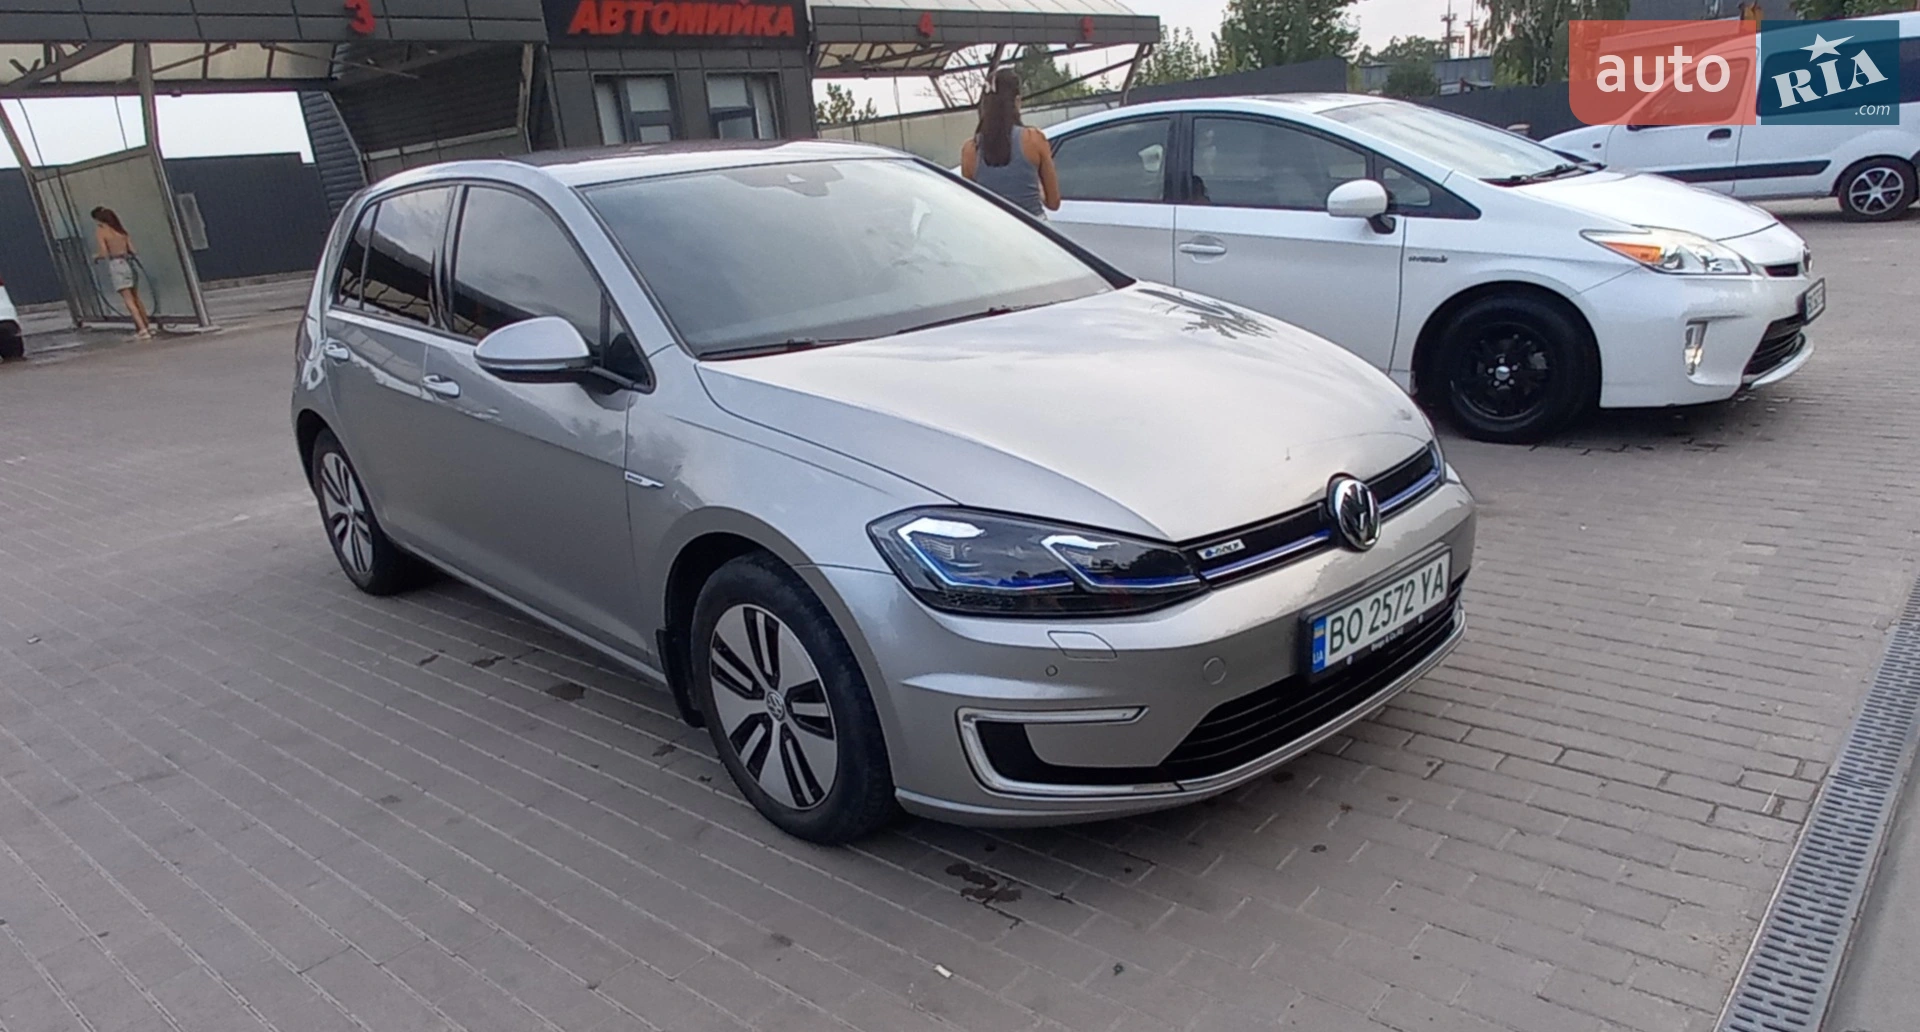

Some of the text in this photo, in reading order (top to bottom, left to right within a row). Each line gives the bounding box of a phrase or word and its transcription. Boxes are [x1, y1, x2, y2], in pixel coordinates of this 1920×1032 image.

[345, 0, 375, 32] 3
[568, 0, 795, 36] АВТОМИЙКА
[1329, 606, 1363, 656] BO
[1368, 579, 1416, 636] 2572
[1421, 562, 1444, 605] YA
[1312, 651, 1324, 664] UA
